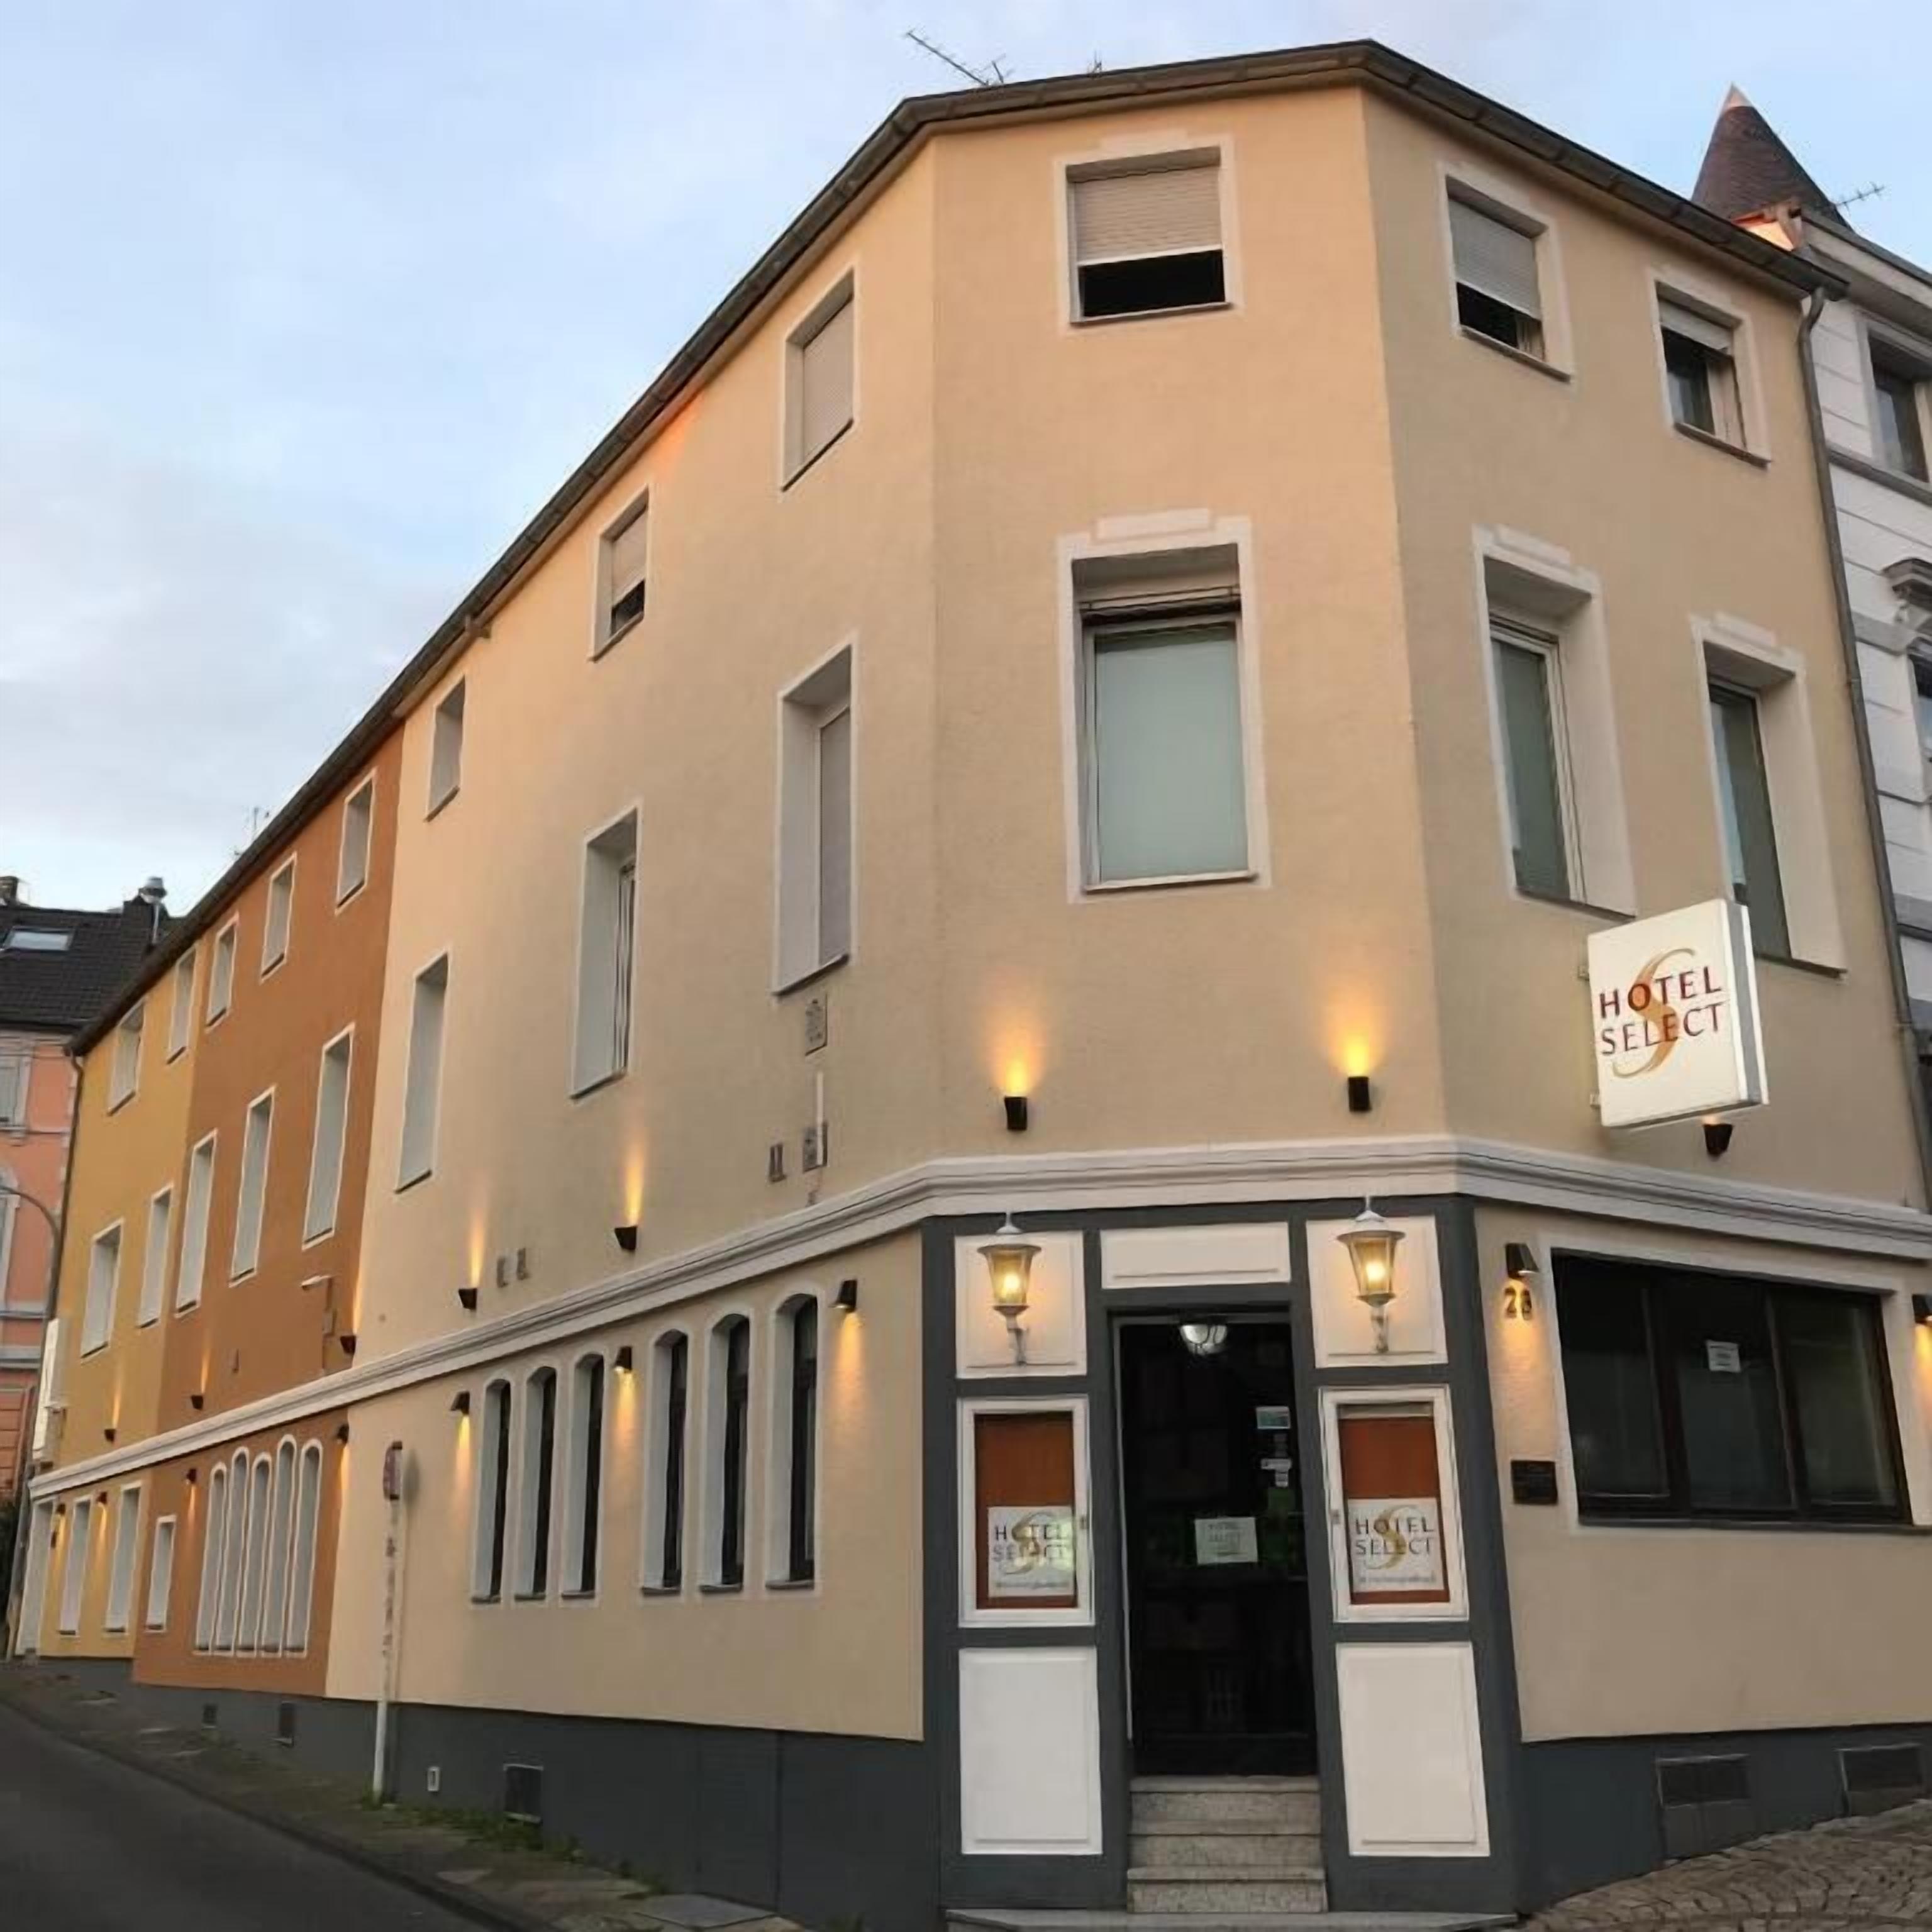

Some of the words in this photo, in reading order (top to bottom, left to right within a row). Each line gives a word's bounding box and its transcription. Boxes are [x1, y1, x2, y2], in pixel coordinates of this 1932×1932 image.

[1599, 965, 1722, 1019] HOTEL
[1601, 1001, 1726, 1055] SELECT
[1355, 1516, 1435, 1535] HOTEL
[1355, 1536, 1435, 1555] SELECT
